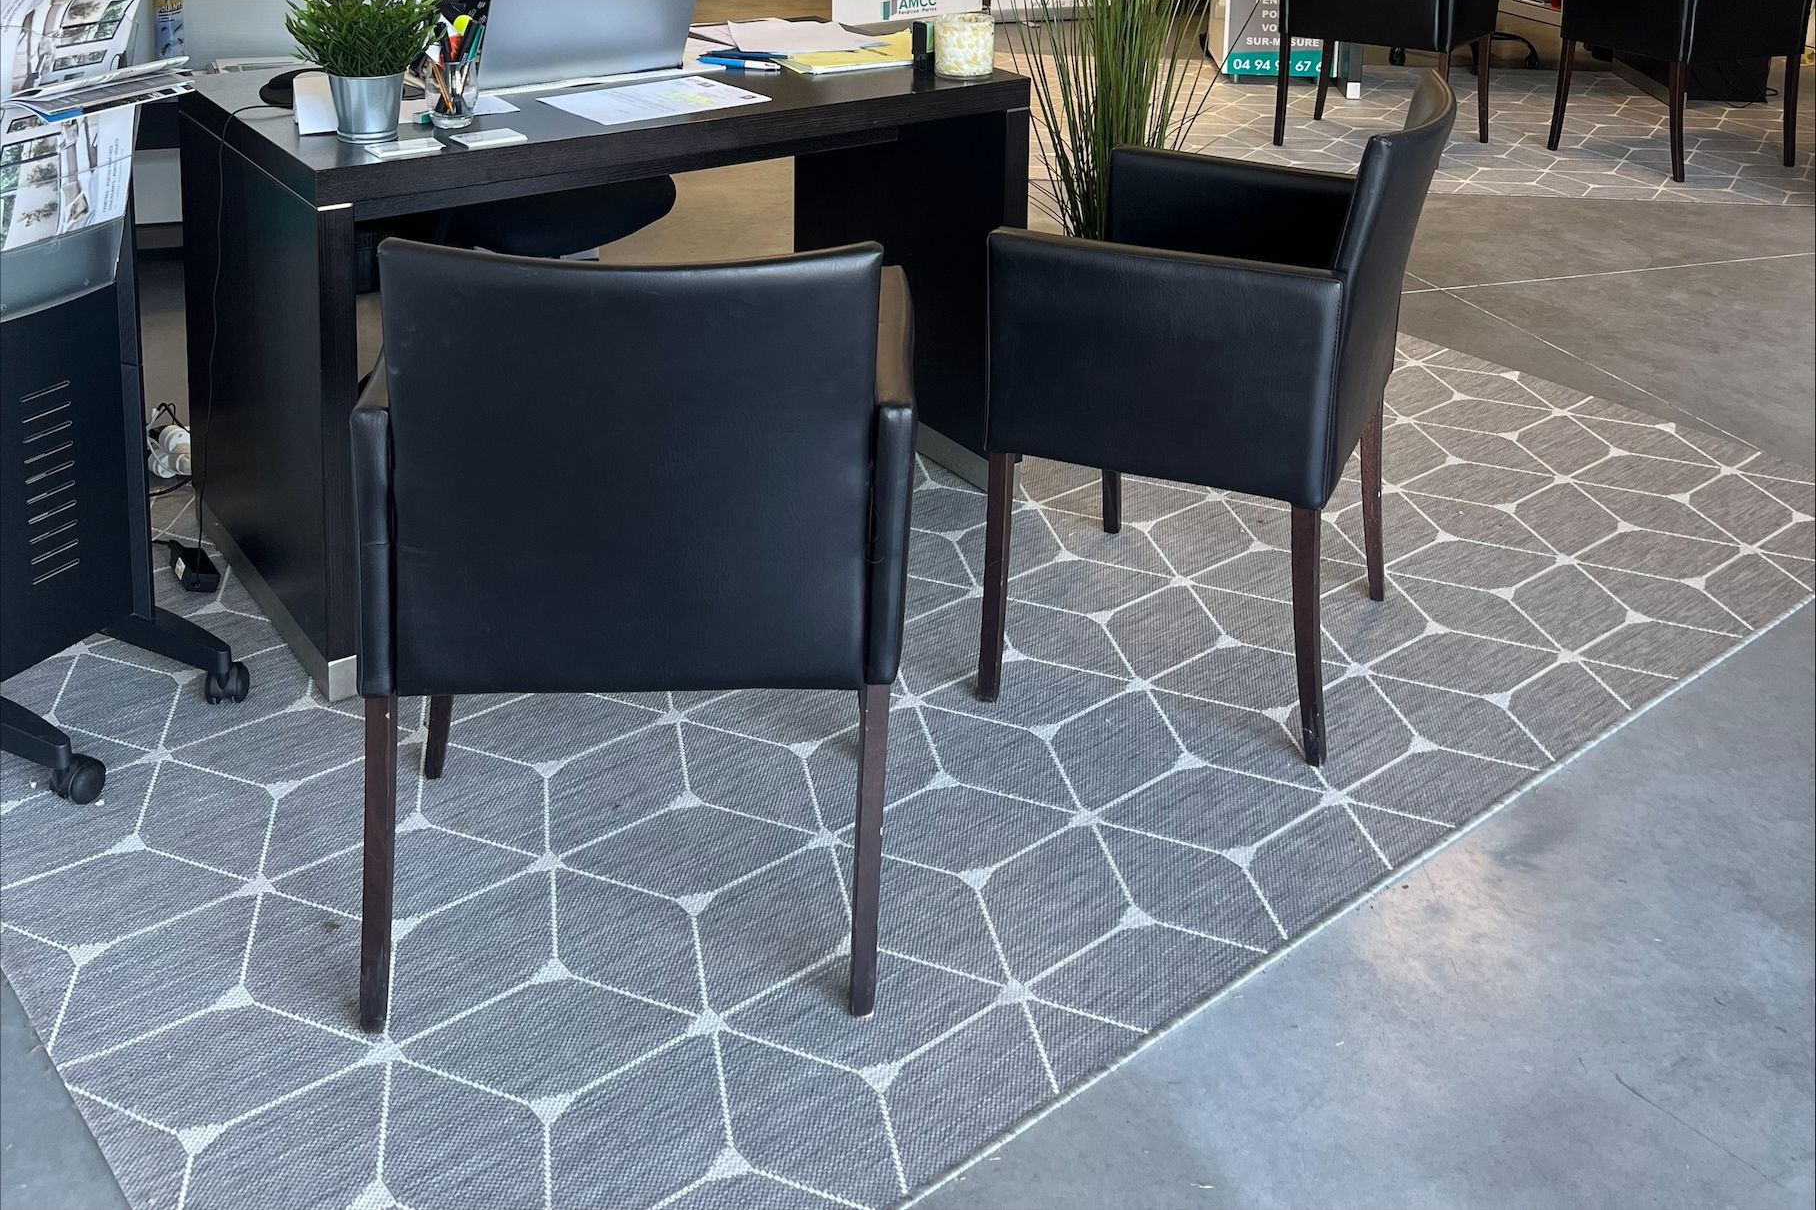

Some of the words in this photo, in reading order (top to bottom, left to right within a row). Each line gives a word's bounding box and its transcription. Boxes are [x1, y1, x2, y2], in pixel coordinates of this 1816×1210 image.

[1261, 9, 1279, 19] PO
[1261, 23, 1278, 32] VO
[1246, 36, 1320, 46] SUR-MSURE
[1233, 58, 1250, 70] 04
[1254, 59, 1271, 71] 94
[1295, 60, 1312, 72] 67
